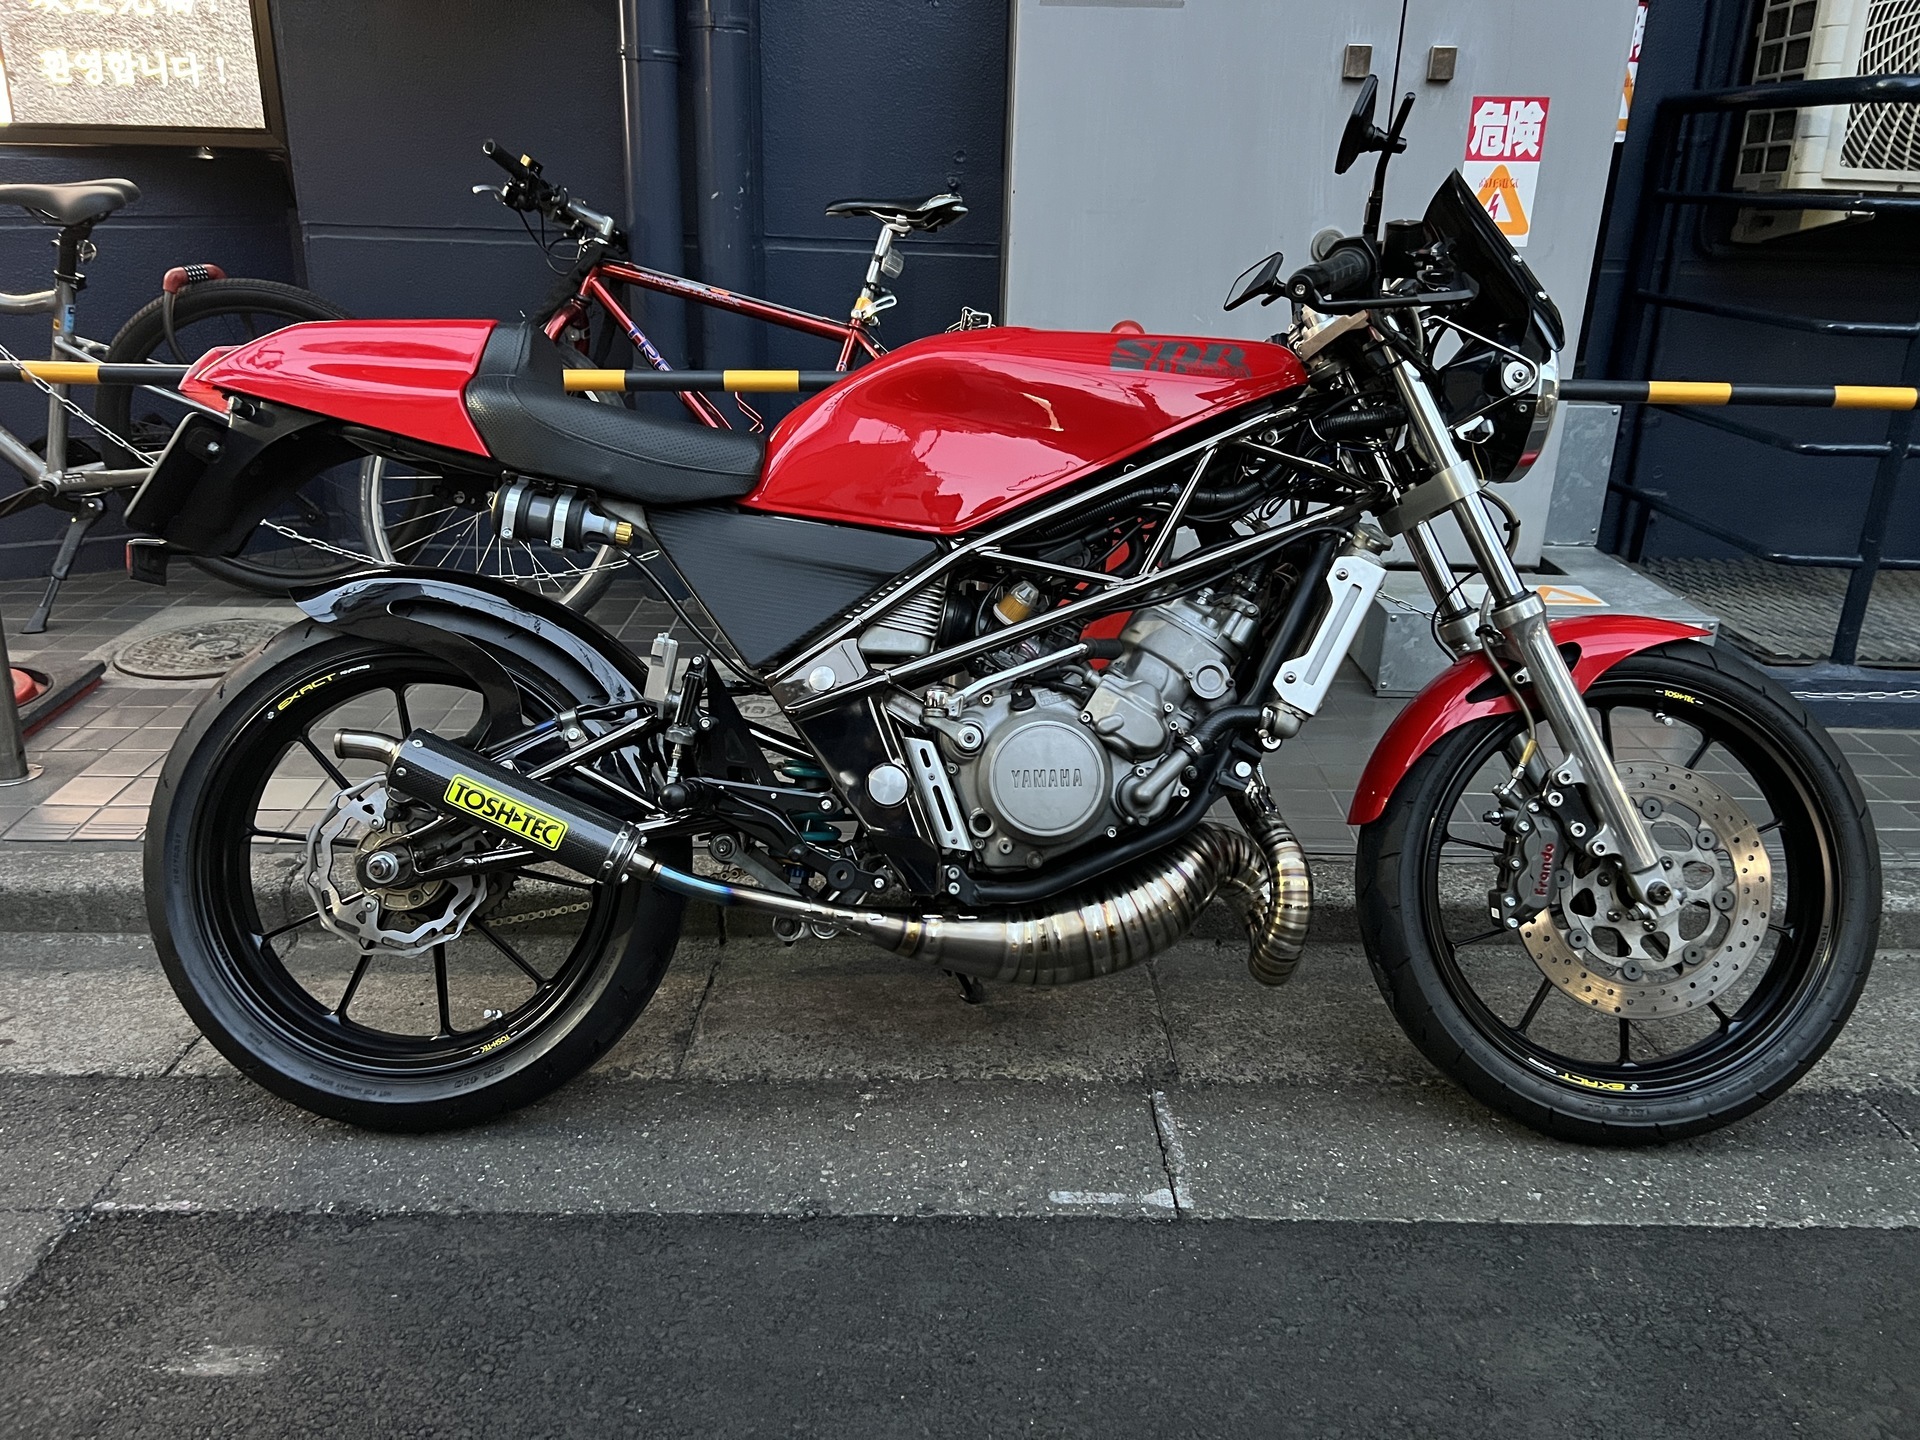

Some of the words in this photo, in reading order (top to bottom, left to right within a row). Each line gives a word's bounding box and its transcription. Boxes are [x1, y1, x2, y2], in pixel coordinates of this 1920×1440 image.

[39, 48, 204, 88] 환영합니다
[1468, 100, 1546, 158] 危険
[627, 320, 674, 371] TRE
[277, 672, 336, 711] EXACT
[1011, 768, 1083, 788] YAMAHA
[1558, 1072, 1626, 1091] EXACT
